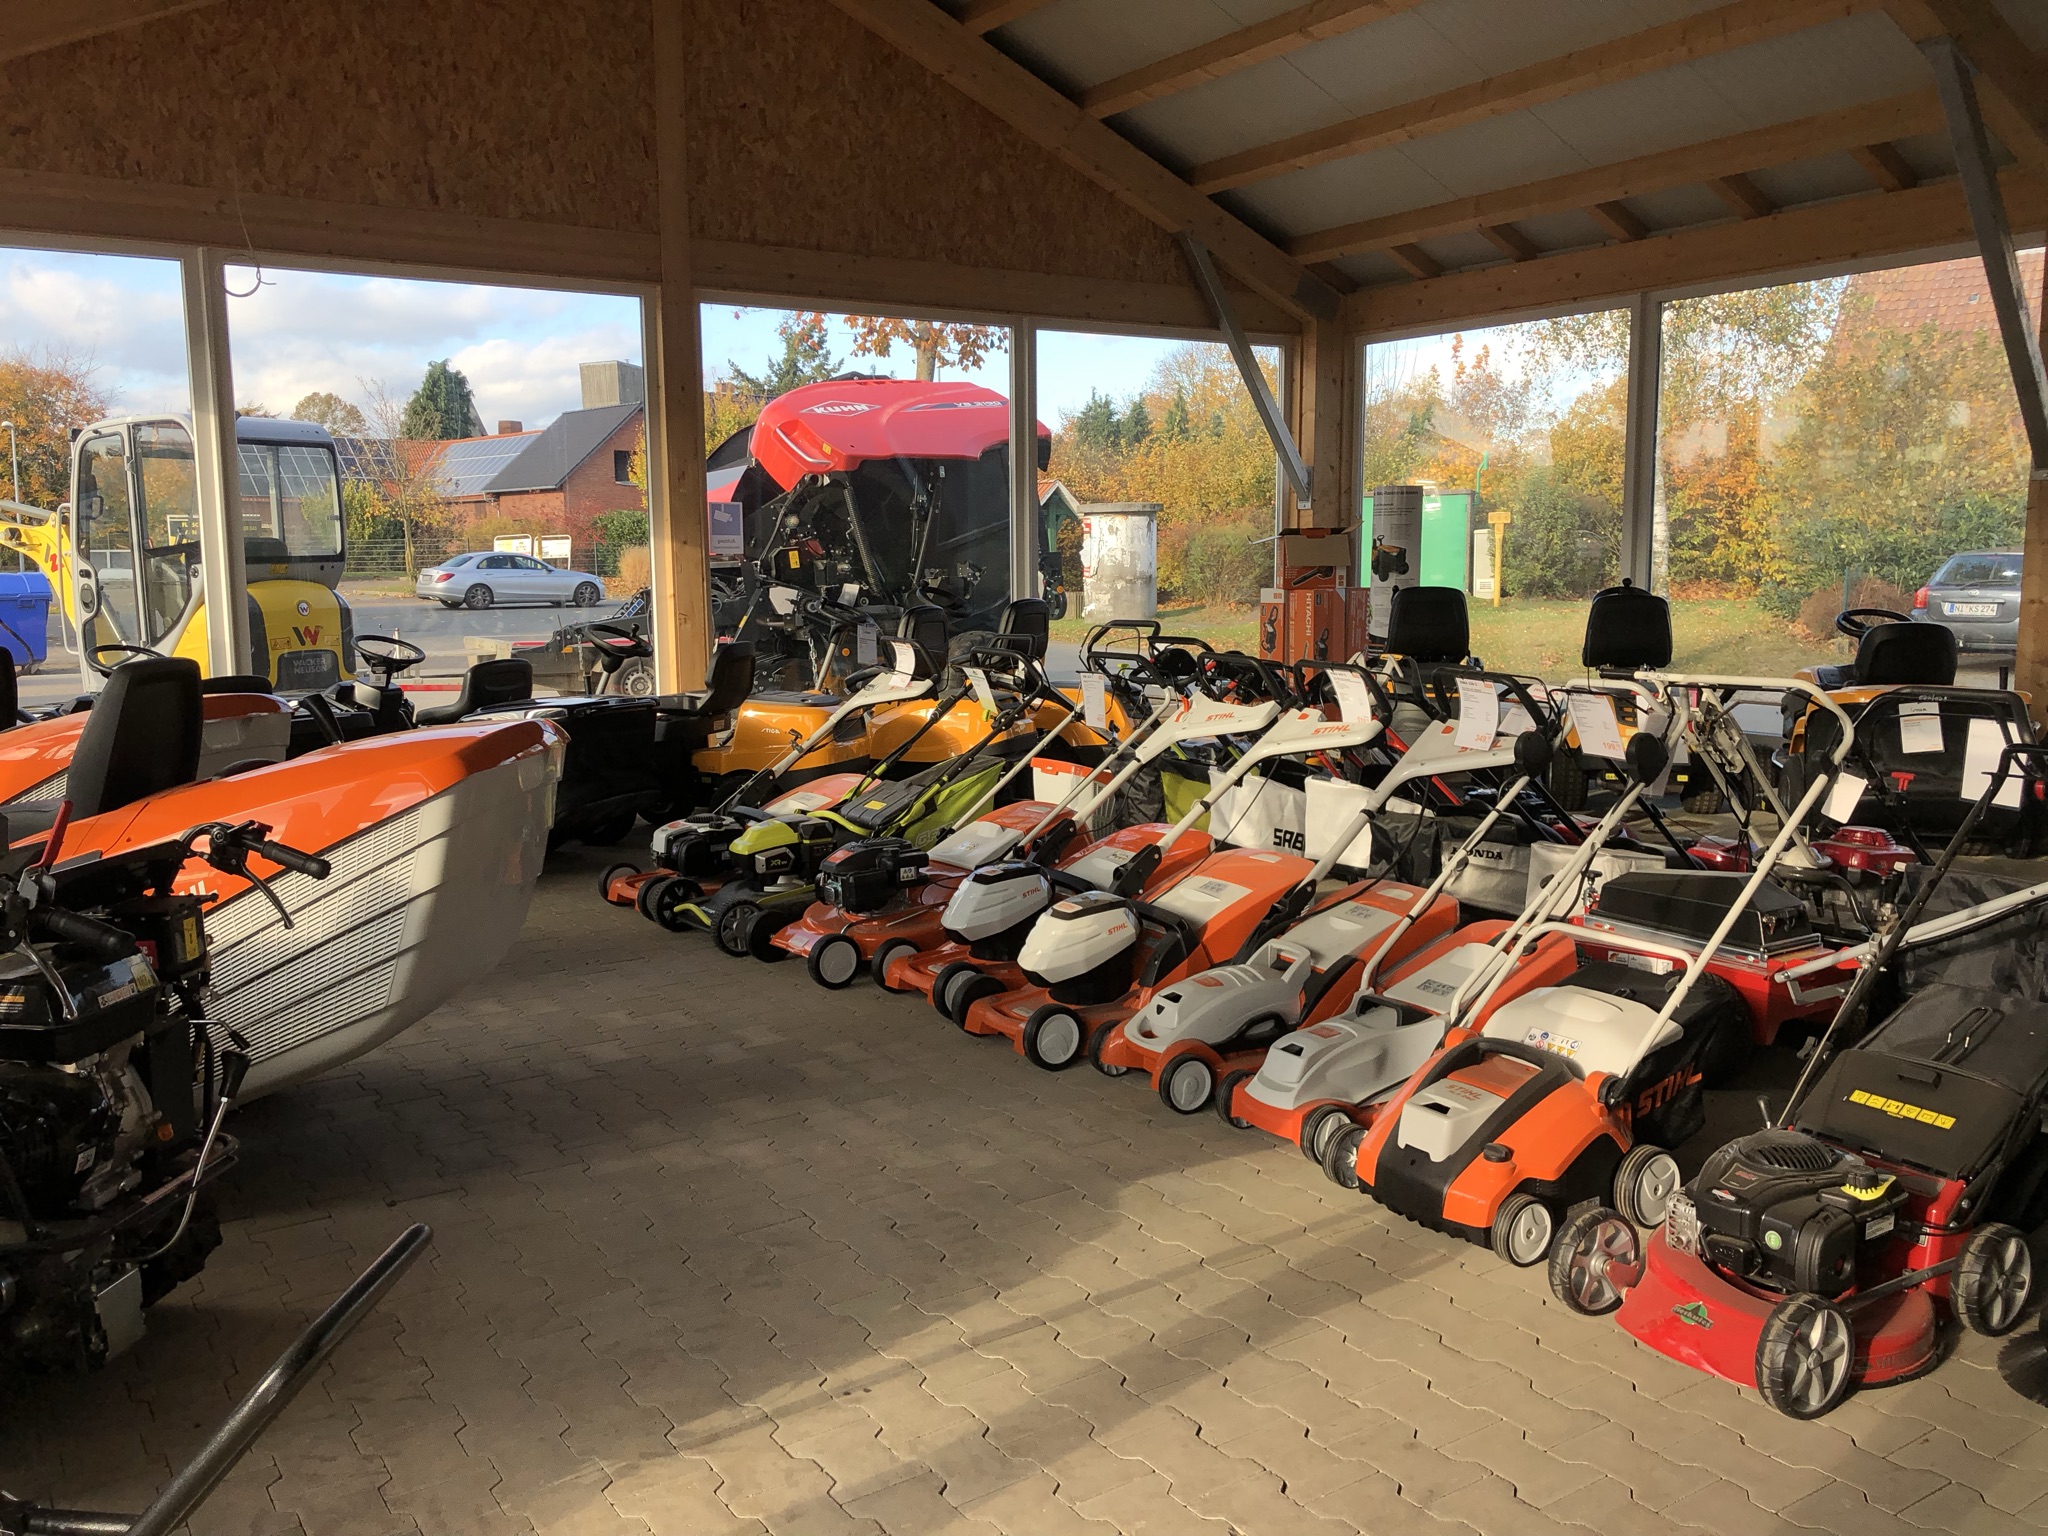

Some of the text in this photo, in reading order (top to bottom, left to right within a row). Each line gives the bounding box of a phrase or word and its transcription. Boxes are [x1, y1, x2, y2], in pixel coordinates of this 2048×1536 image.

[813, 402, 870, 414] KUHN
[1969, 605, 1980, 613] KS
[1980, 605, 1996, 613] 274
[293, 659, 326, 667] WACKER
[293, 666, 328, 675] NEUSON
[1205, 711, 1236, 722] STIHL
[1311, 724, 1351, 736] STIHL
[1022, 886, 1041, 899] STIHL
[1107, 922, 1128, 936] STIHL
[1636, 1062, 1703, 1119] STIHL
